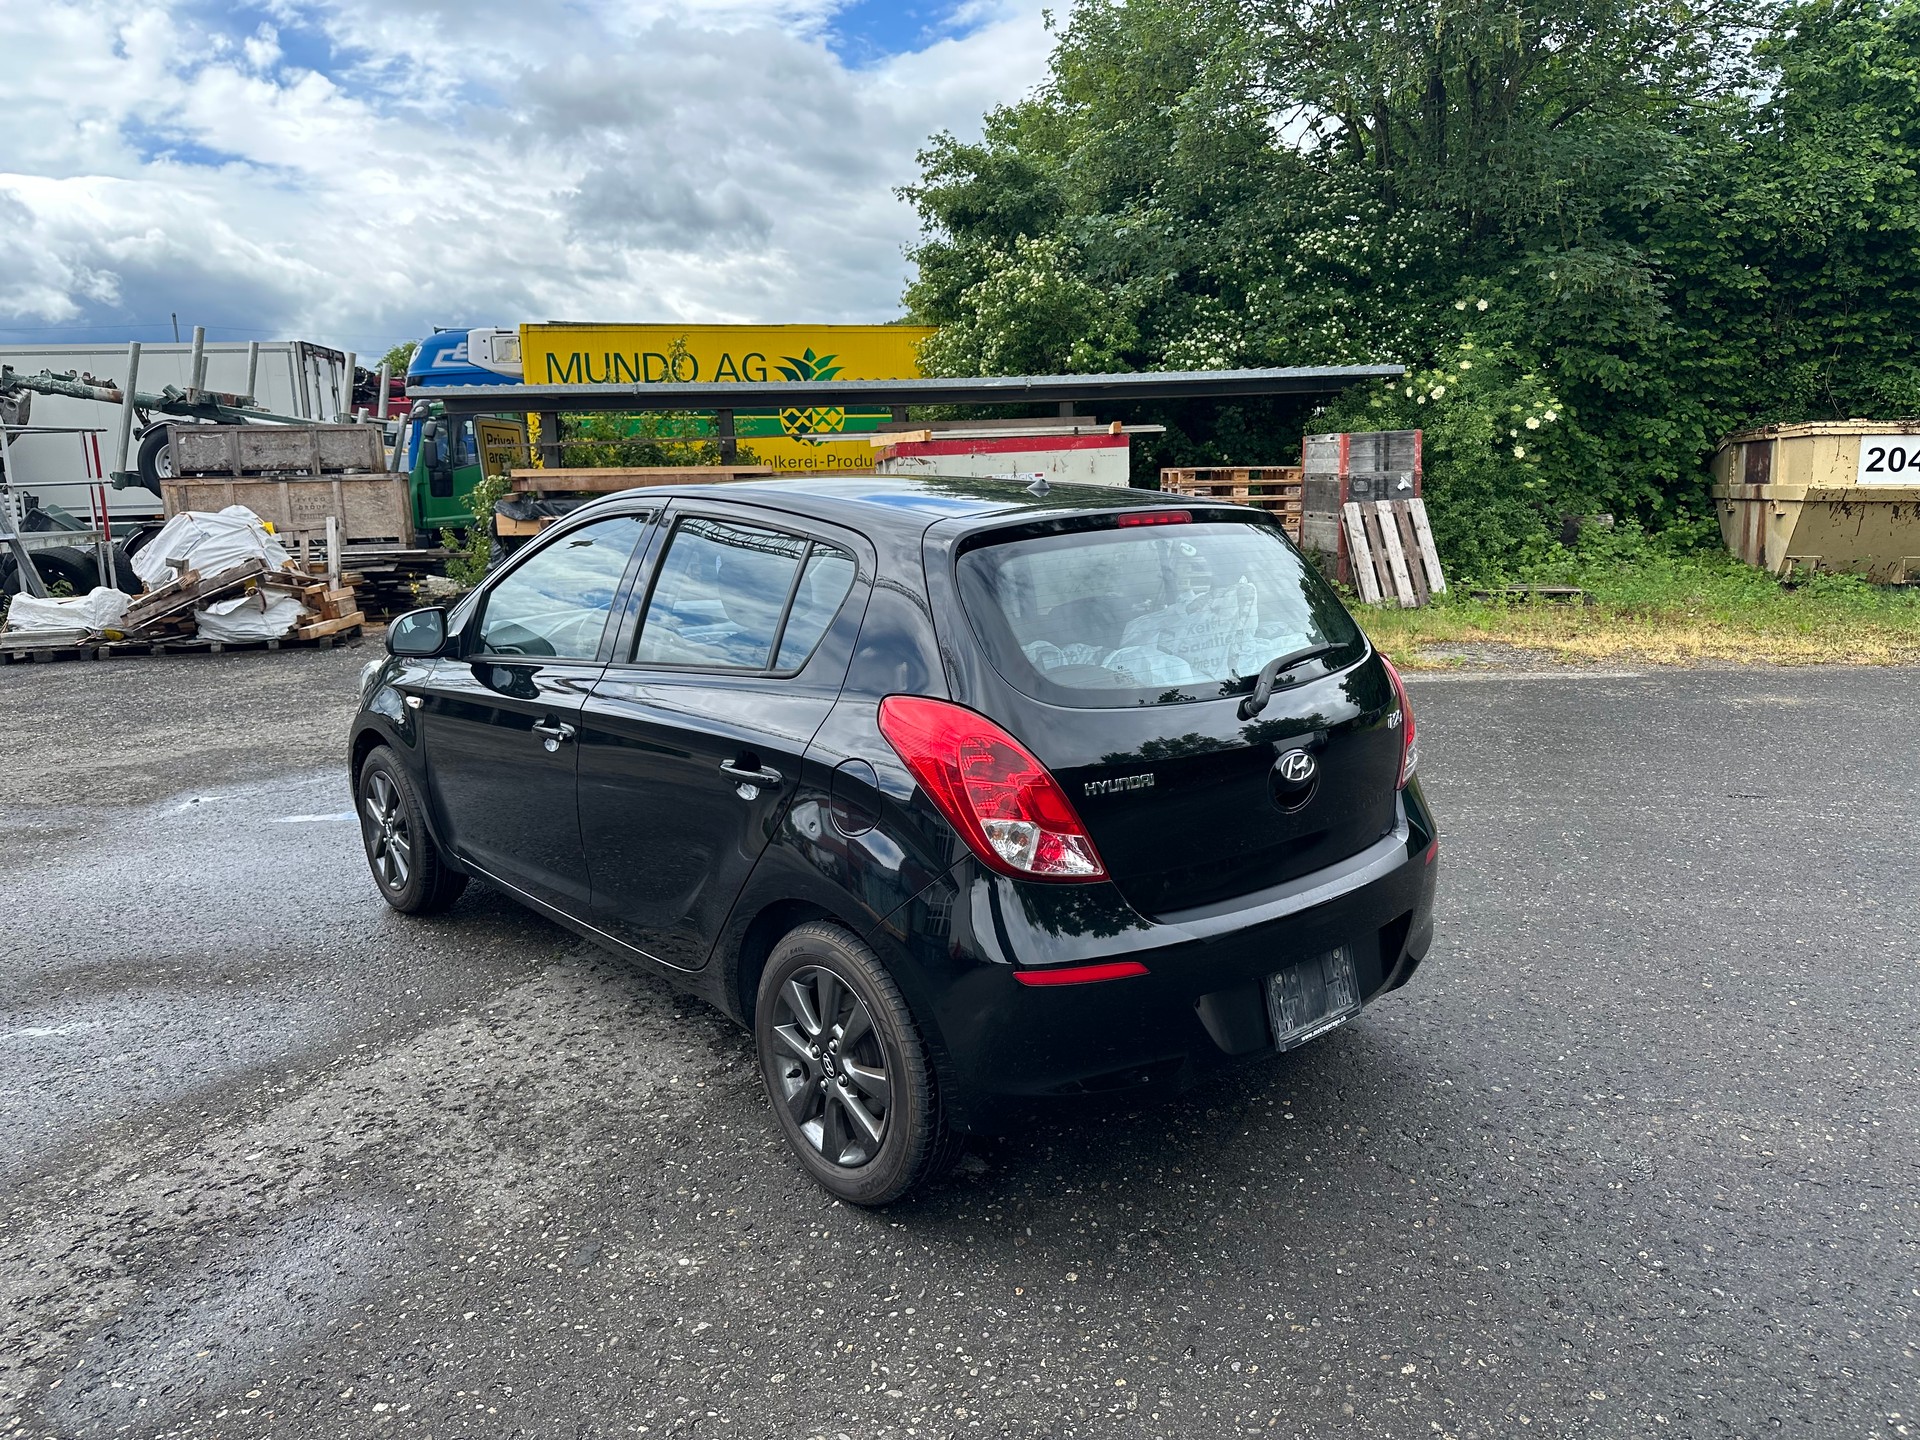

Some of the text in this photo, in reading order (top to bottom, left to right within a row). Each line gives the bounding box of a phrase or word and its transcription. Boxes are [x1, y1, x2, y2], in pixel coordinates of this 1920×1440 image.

[545, 352, 767, 382] MUNDO AG
[1084, 773, 1155, 796] HYUNDAI
